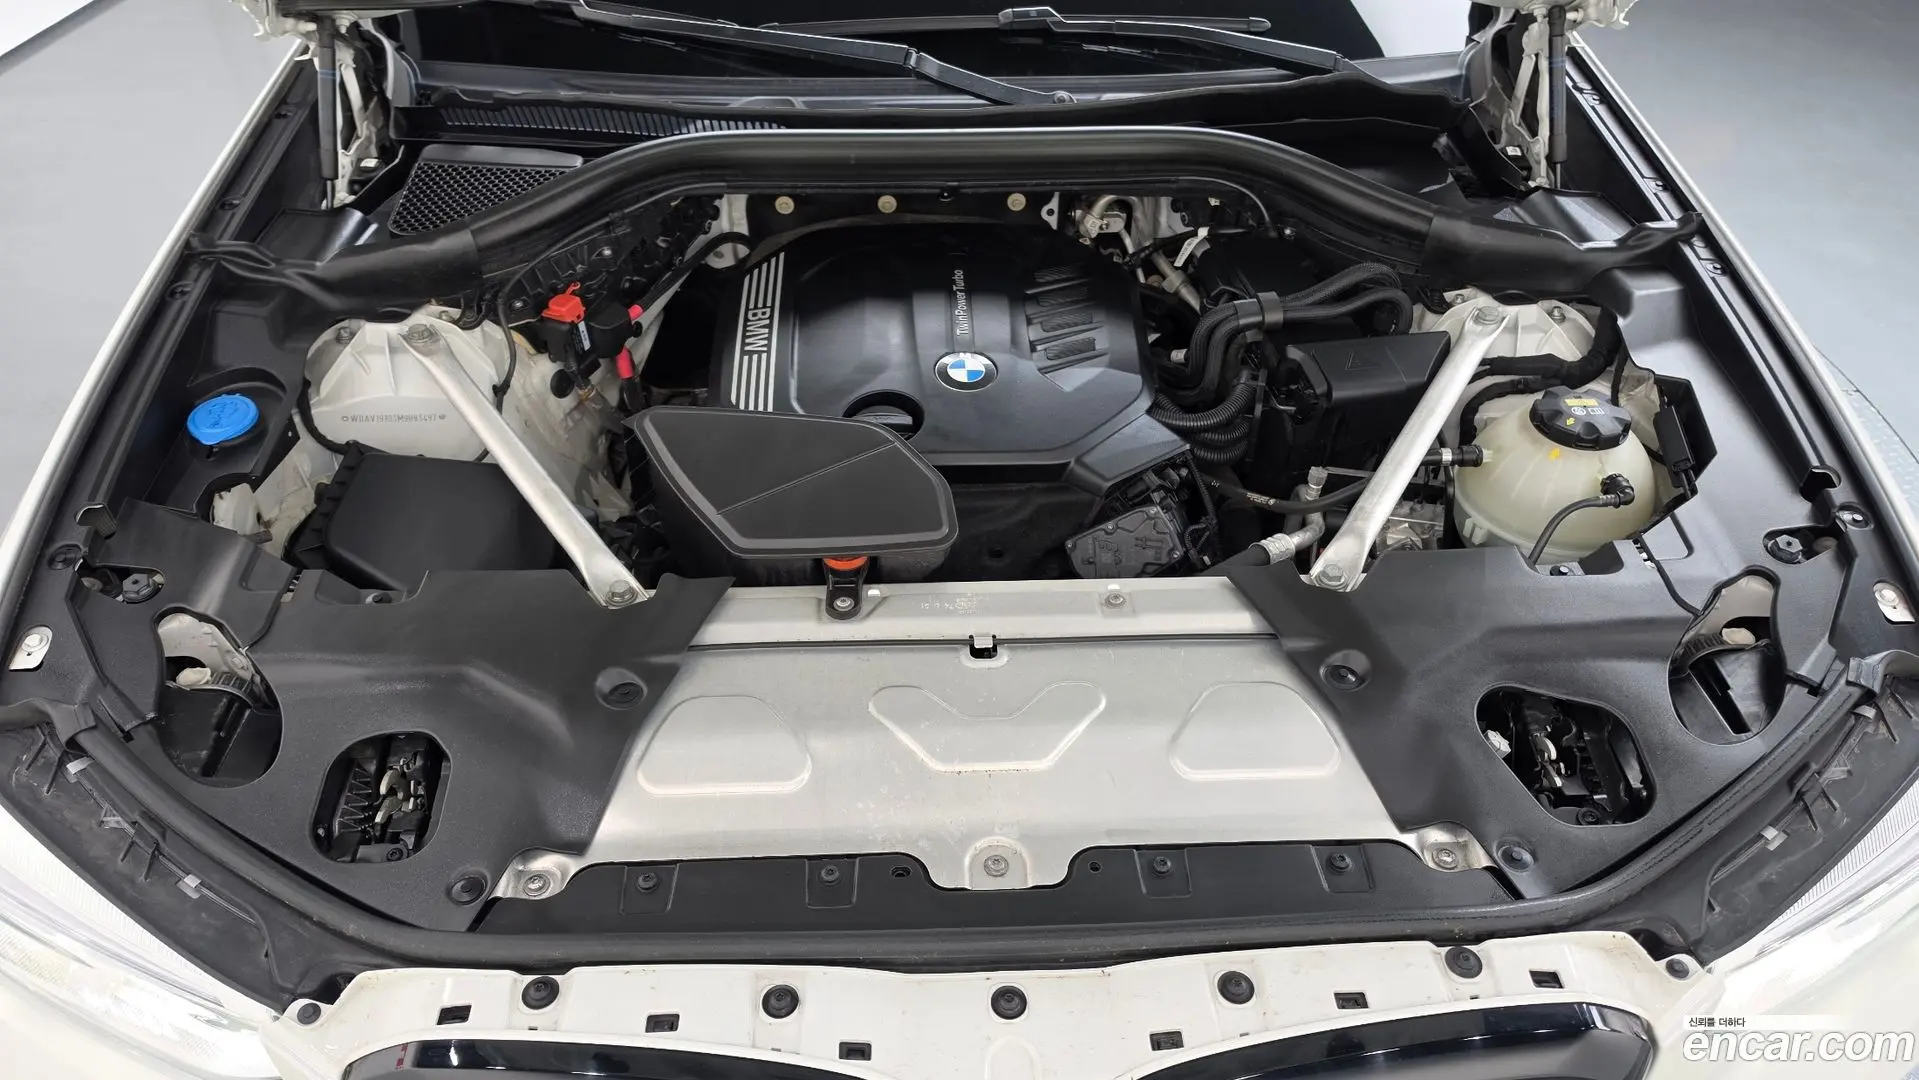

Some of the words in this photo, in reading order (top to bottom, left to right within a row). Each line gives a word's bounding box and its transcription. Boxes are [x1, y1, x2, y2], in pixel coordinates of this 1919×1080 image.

[952, 269, 965, 291] Turbo
[744, 307, 771, 351] BMW
[955, 291, 968, 336] TwinPower
